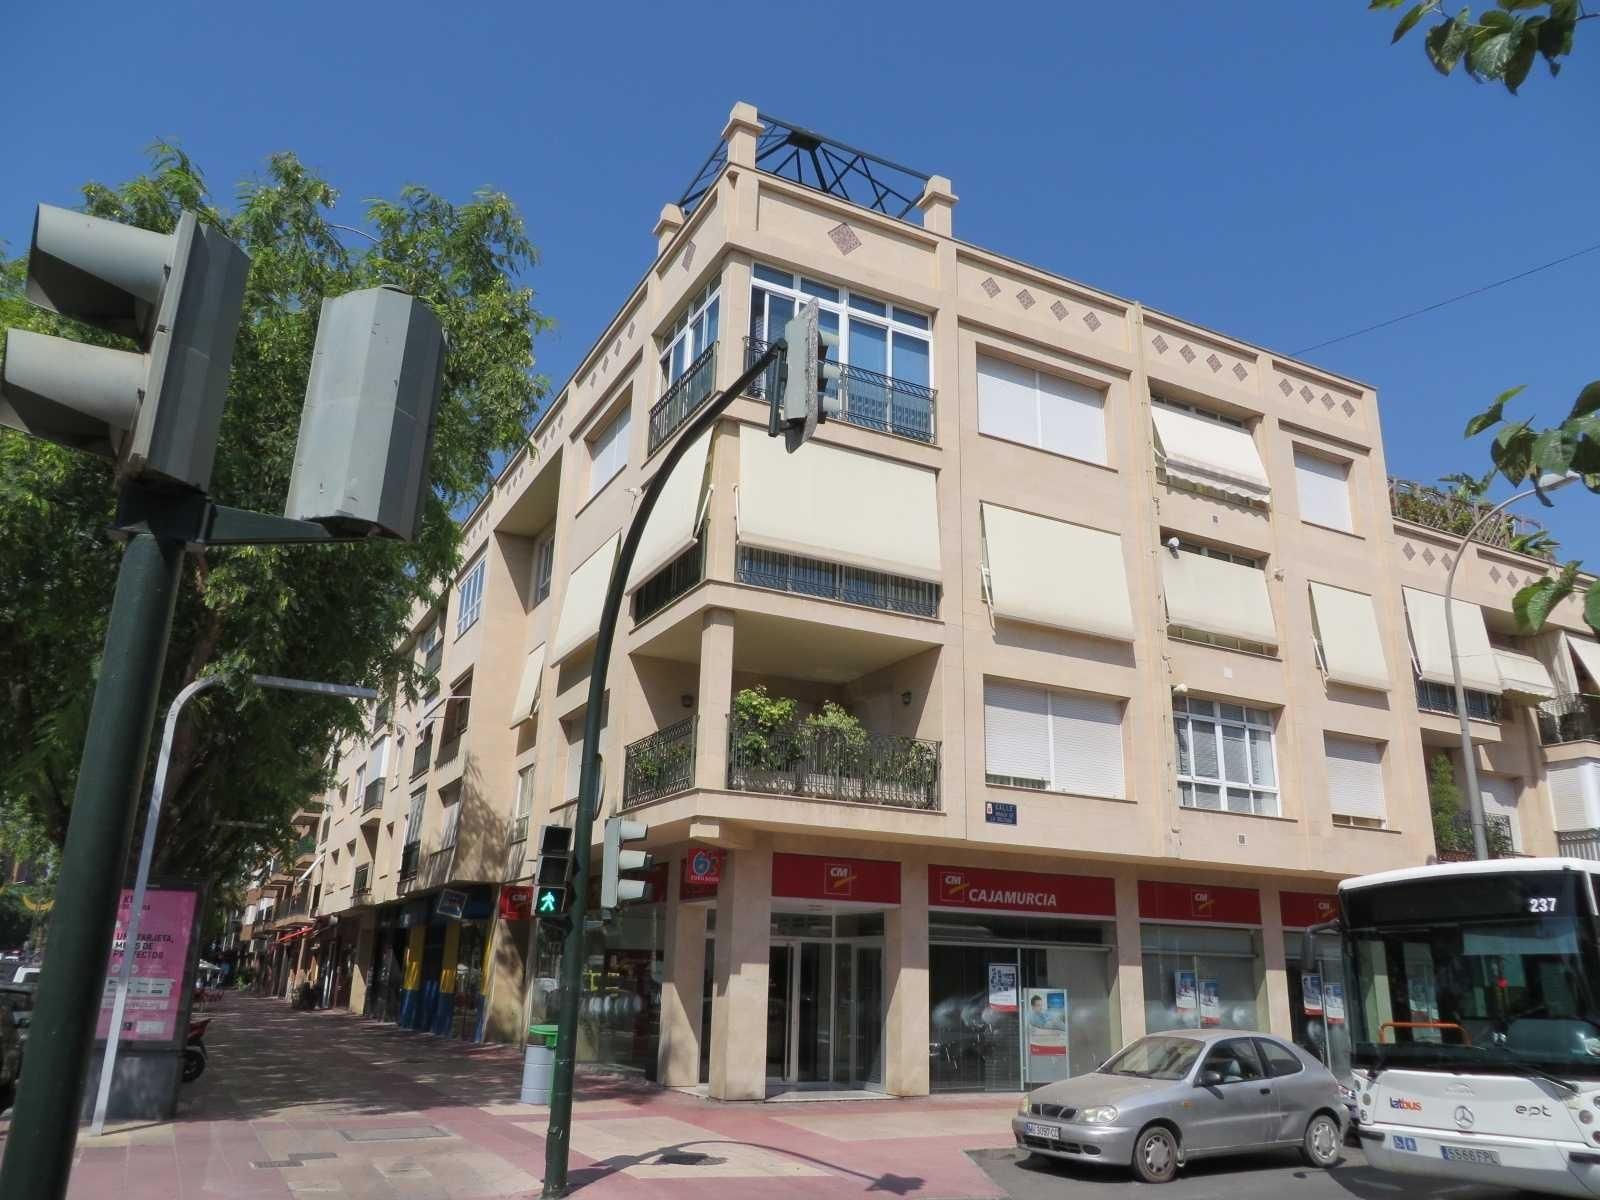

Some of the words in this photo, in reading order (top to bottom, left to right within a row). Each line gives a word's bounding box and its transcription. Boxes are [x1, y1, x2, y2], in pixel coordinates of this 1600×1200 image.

[830, 867, 849, 878] CM
[944, 875, 962, 885] CM
[968, 888, 1057, 907] CAJAMURCIA
[1530, 897, 1557, 912] 237
[1389, 1096, 1422, 1111] latbus
